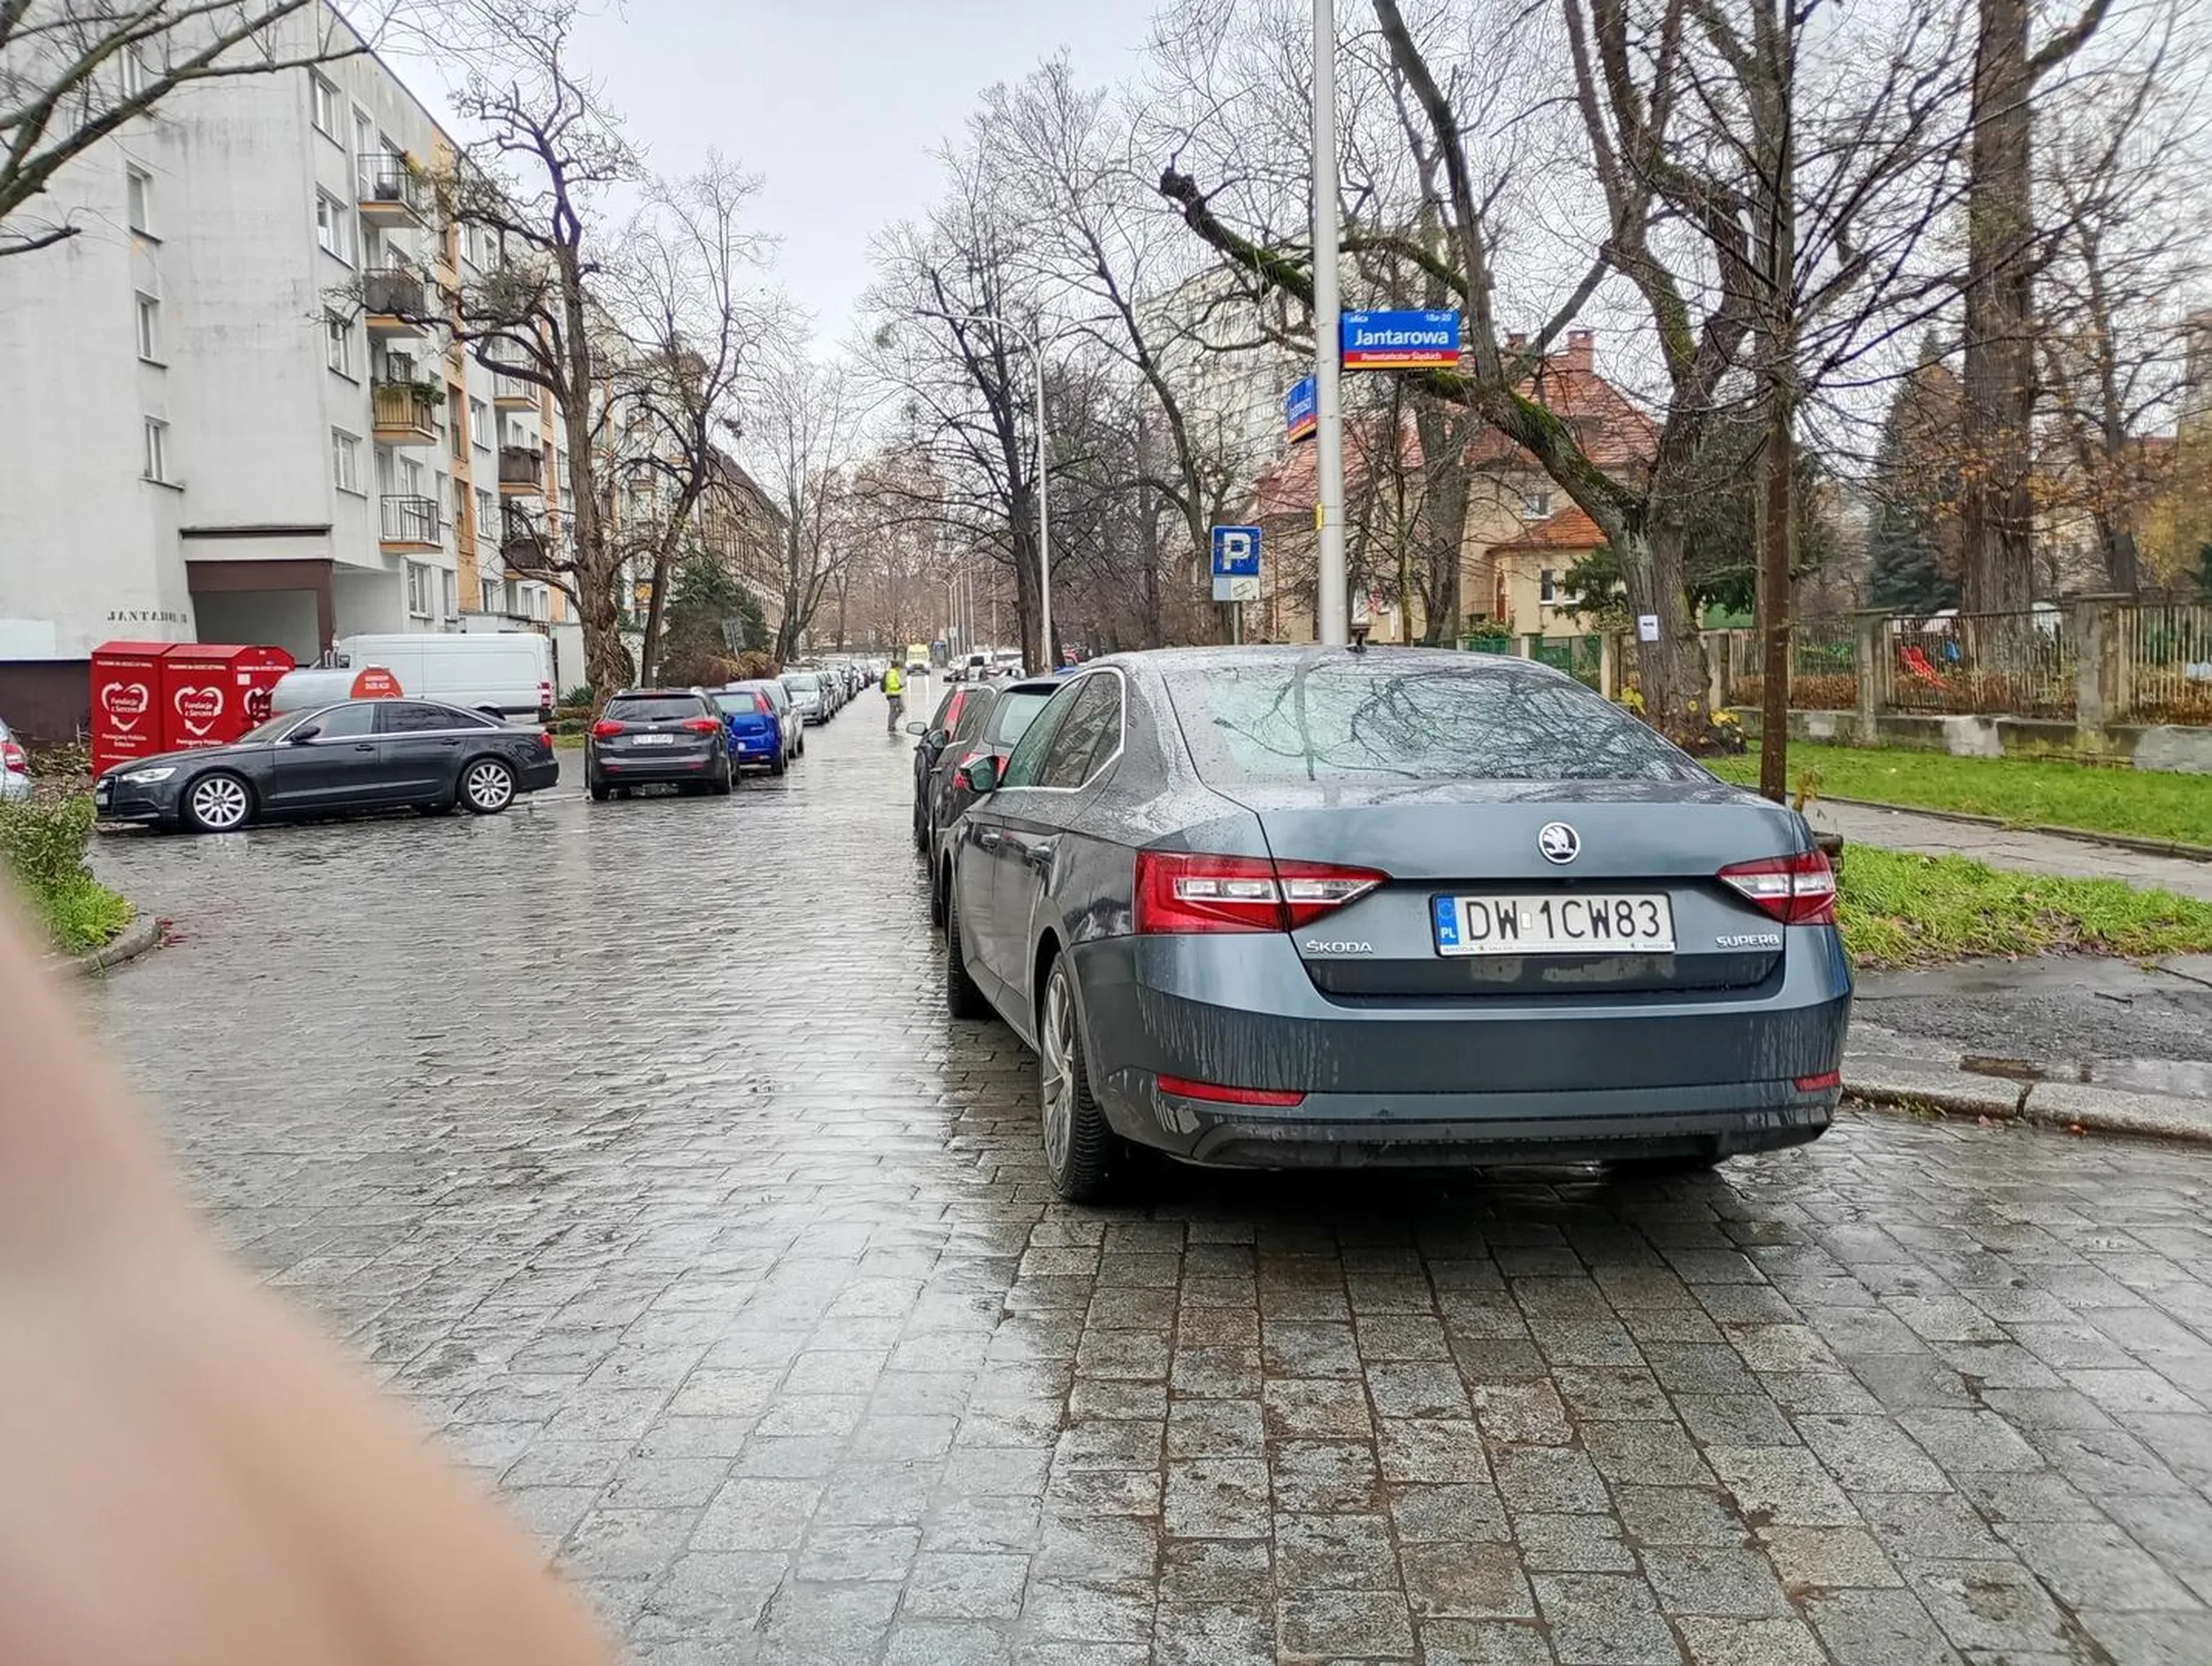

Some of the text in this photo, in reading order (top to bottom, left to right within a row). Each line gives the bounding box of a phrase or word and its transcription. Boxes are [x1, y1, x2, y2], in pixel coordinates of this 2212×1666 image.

[1354, 328, 1449, 346] Jantarowa
[1222, 532, 1251, 572] P
[1465, 898, 1661, 941] DW 1CW83
[1440, 928, 1456, 940] PL
[1715, 933, 1780, 949] SUPERB
